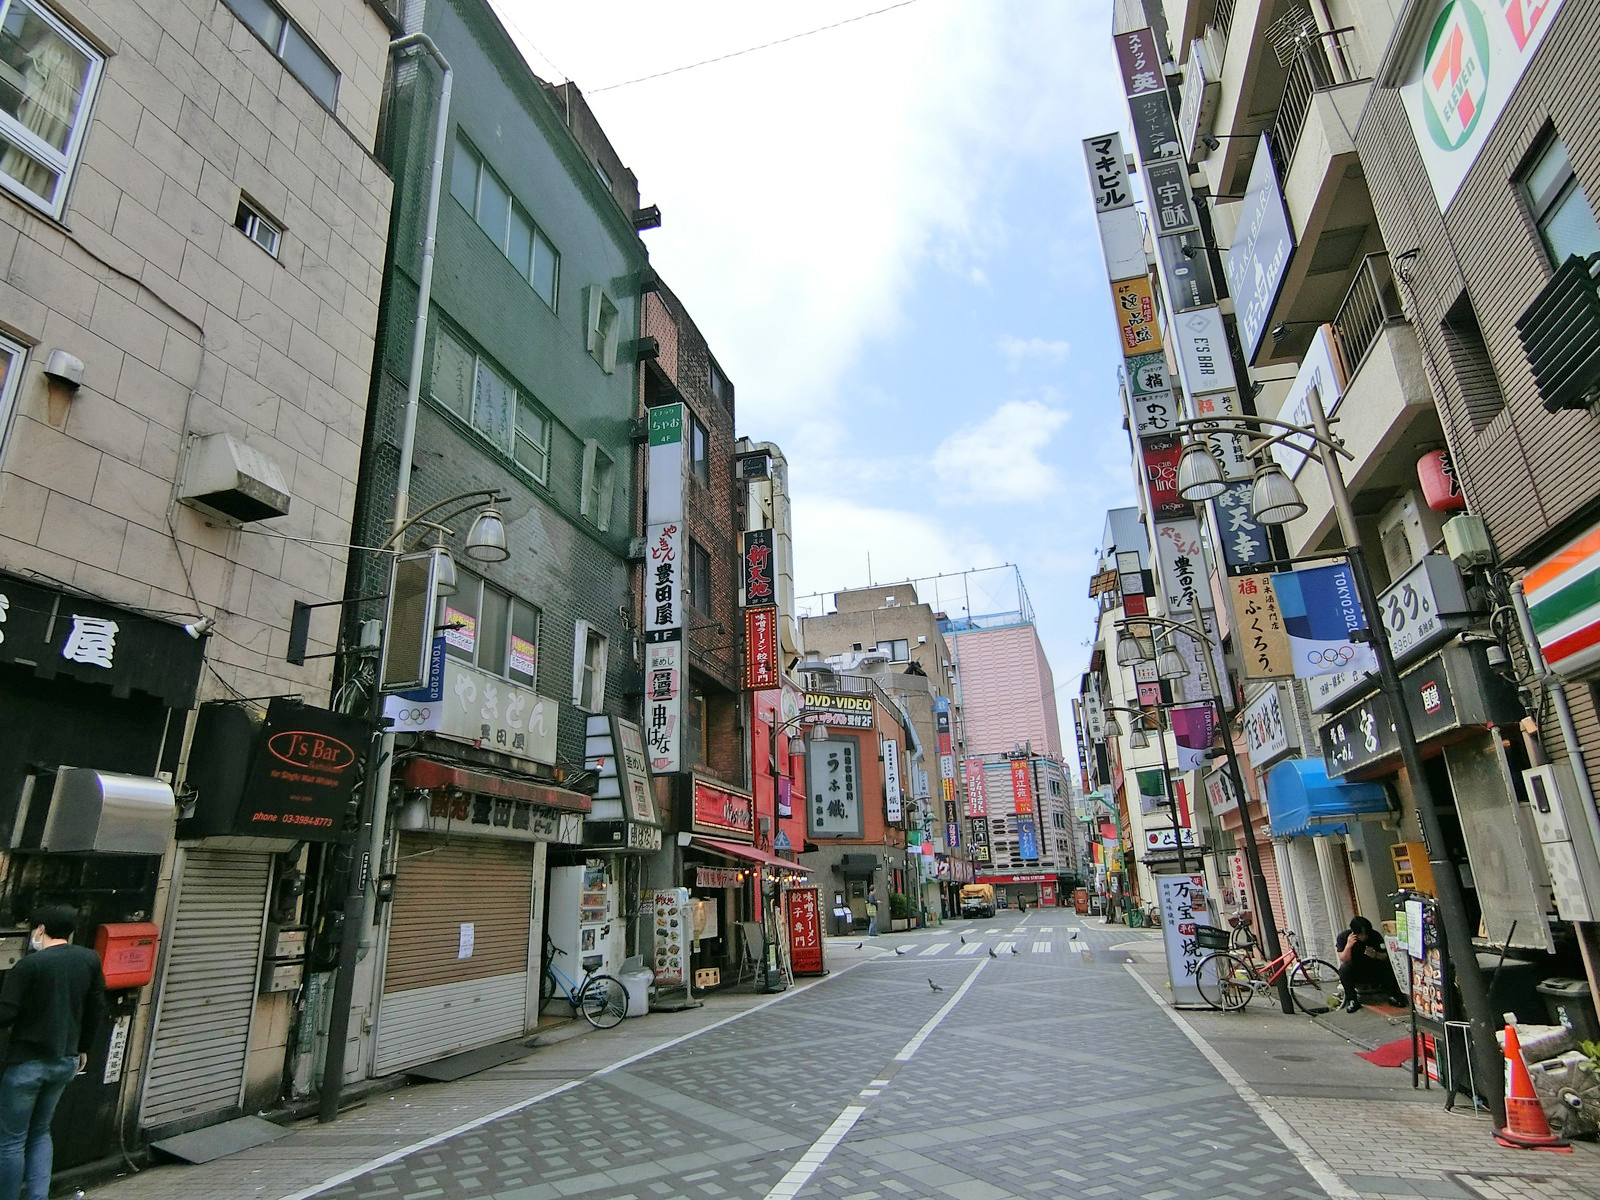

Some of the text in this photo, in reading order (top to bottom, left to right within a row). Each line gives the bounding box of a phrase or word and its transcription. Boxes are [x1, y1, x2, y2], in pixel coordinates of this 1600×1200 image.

[1128, 34, 1146, 70] スナック
[1131, 72, 1158, 93] 英
[1091, 138, 1126, 207] マキビル
[1194, 338, 1216, 376] E'S BAR
[652, 418, 681, 431] ちゃお
[1138, 422, 1148, 431] 3F
[1146, 403, 1170, 430] のむ
[660, 435, 671, 443] 4F
[651, 524, 677, 562] やきとん
[1160, 526, 1200, 556] やきとん
[1229, 507, 1260, 562] 天幸
[746, 545, 773, 599] 新天地
[1173, 554, 1198, 607] 豊田屋
[1237, 577, 1258, 595] 福
[1333, 572, 1349, 607] TOKYO
[653, 562, 675, 626] 豊田屋
[1168, 595, 1179, 605] 1F
[1261, 577, 1280, 631] 日本酒専門店
[63, 613, 120, 669] 屋
[654, 630, 674, 642] 1F
[1244, 600, 1273, 673] ふくろう。
[430, 644, 442, 699] TOKYO 2020
[651, 657, 675, 668] 釜めし
[453, 672, 548, 738] やきとん
[1204, 710, 1212, 731] TOKYO
[480, 723, 525, 750] 豊田屋
[646, 703, 671, 754] 串はな
[285, 735, 341, 762] J's Bar
[1332, 742, 1354, 767] らーめん
[252, 811, 278, 823] phone
[803, 891, 816, 947] 味噌ラーメン
[1173, 881, 1196, 921] 万宝
[791, 892, 806, 947] 餃子専門
